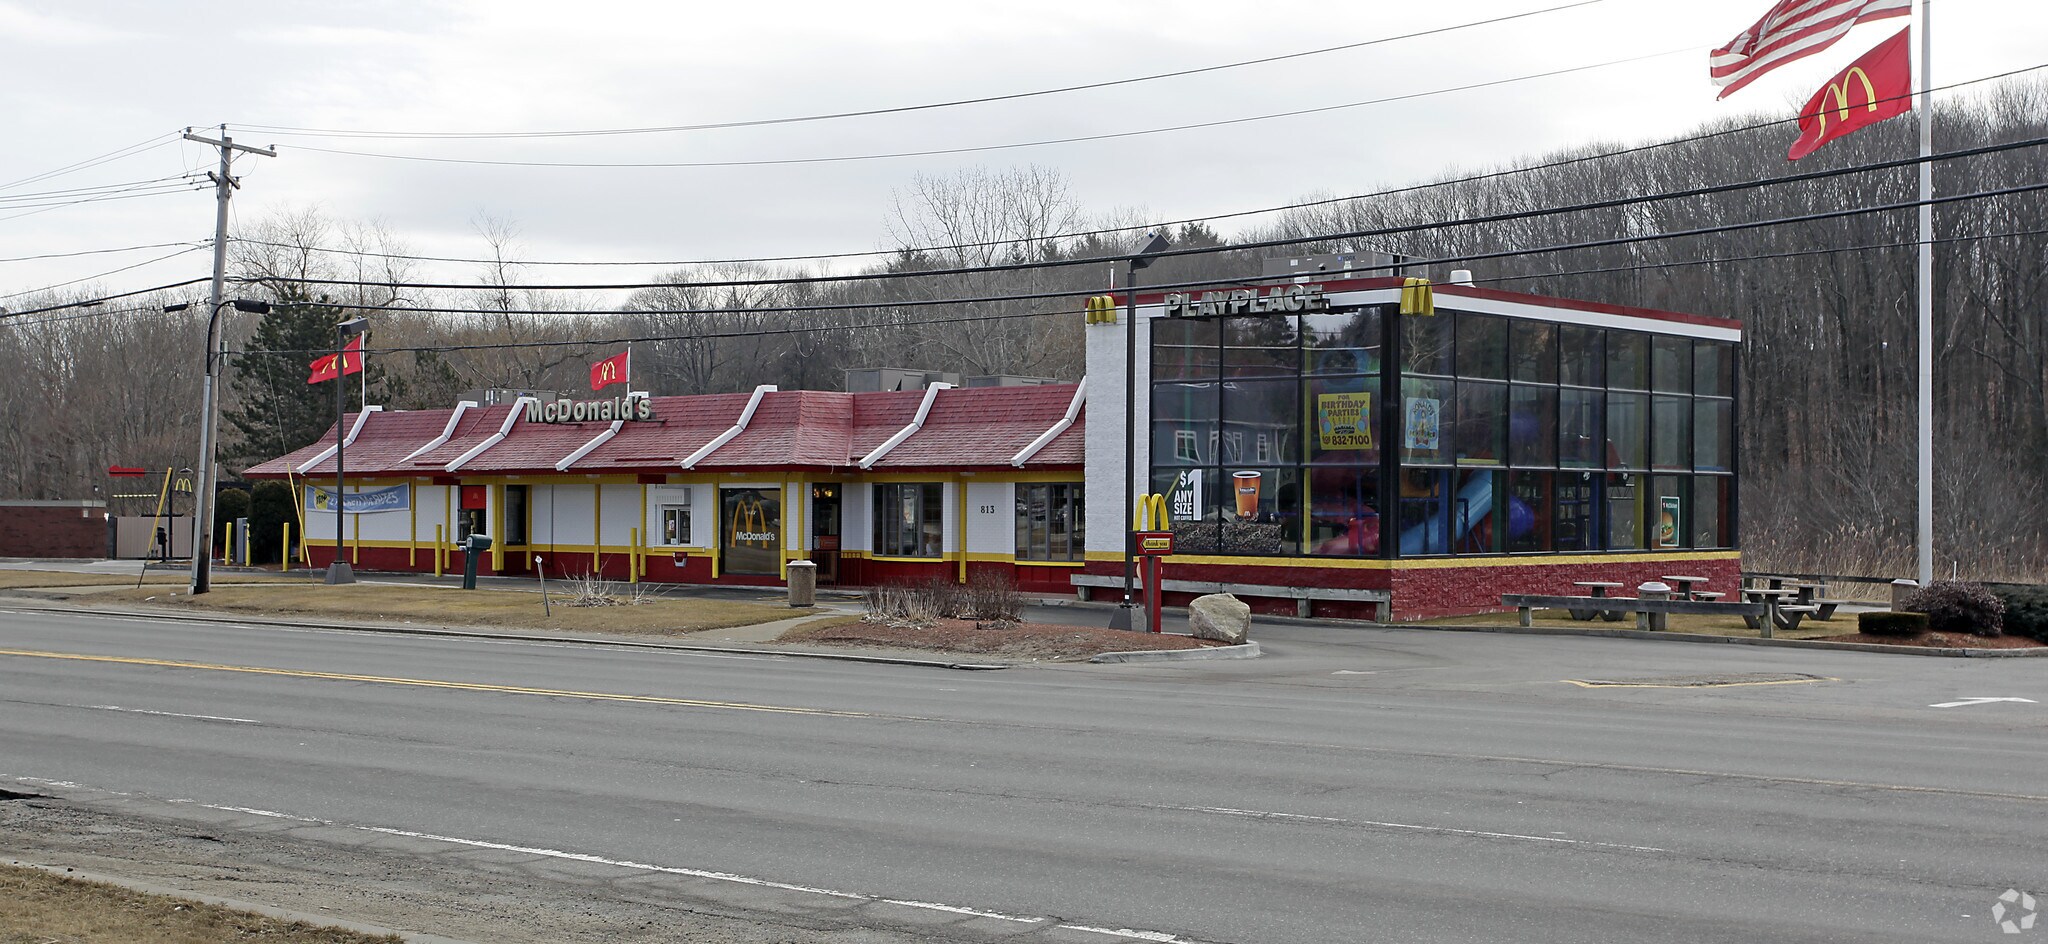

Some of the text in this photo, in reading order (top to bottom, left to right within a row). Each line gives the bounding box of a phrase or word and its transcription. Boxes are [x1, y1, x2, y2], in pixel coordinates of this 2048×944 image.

[1164, 284, 1324, 317] PLAYPLACE
[525, 396, 652, 423] McDonald's
[1322, 400, 1366, 409] BIRTHDAY
[1328, 409, 1360, 417] PARTIES
[1174, 490, 1193, 502] ANY
[980, 505, 995, 514] 813
[1174, 503, 1192, 514] SIZE
[736, 531, 775, 541] McDonald's
